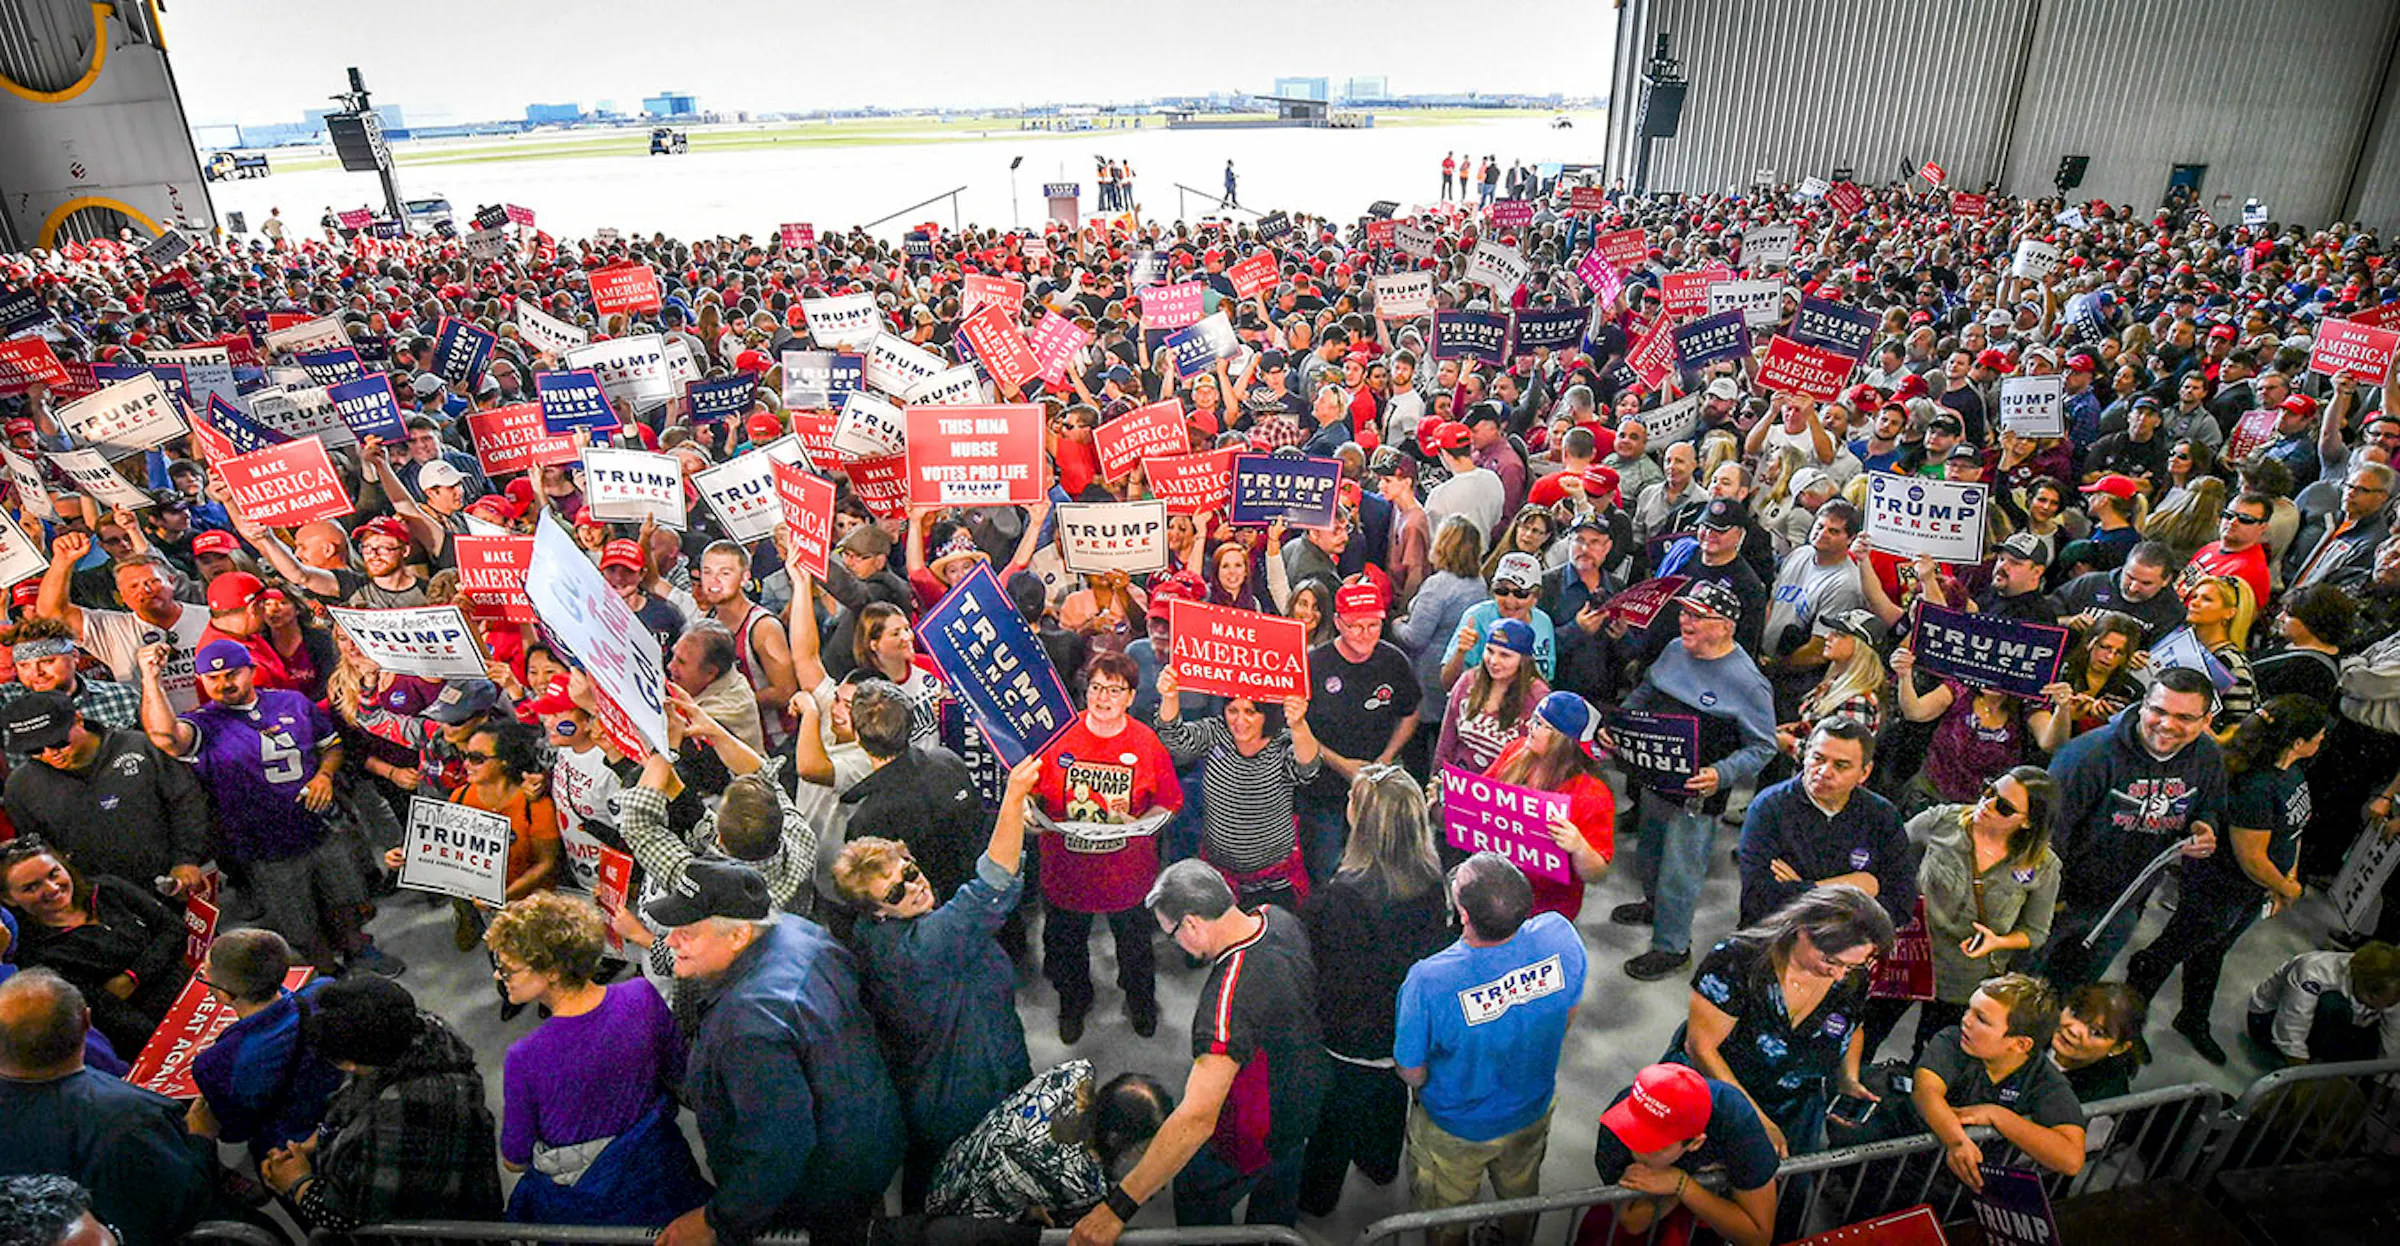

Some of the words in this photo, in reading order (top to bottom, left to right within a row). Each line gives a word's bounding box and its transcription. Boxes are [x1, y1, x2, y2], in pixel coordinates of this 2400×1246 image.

[1478, 251, 1520, 281] TRUMP
[1141, 285, 1201, 302] WOMEN
[1379, 283, 1428, 296] TRUMP
[1713, 290, 1778, 305] TRUMP
[810, 305, 872, 322] TRUMP
[1162, 301, 1184, 312] FOR
[1146, 313, 1200, 327] TRUMP
[1438, 321, 1504, 340] TRUMP
[1519, 319, 1584, 338] TRUMP
[1801, 310, 1872, 338] TRUMP
[1030, 310, 1061, 355] OMEN
[1443, 331, 1497, 346] PENCE
[1680, 321, 1741, 351] TRUMP
[1800, 320, 1861, 347] PENCE
[2341, 331, 2369, 345] MAKE
[444, 326, 468, 379] TRUMP
[977, 315, 1024, 385] AMERICA
[1047, 331, 1084, 379] TRUMP
[1794, 352, 1824, 369] MAKE
[2317, 336, 2390, 366] AMERICA
[0, 355, 58, 379] ERICA
[304, 362, 361, 381] TRUMP
[594, 353, 660, 372] RUMP
[604, 366, 656, 382] ENCE
[1764, 356, 1843, 385] AMERICA
[2317, 352, 2347, 367] GREAT
[2347, 360, 2383, 376] AGAIN
[790, 368, 862, 382] TRUMP
[1765, 369, 1799, 391] GREAT
[1800, 379, 1837, 396] AGAIN
[337, 391, 391, 417] TRUMP
[541, 386, 599, 405] TRUMP
[691, 381, 754, 406] TRUMP
[70, 393, 158, 435] TRUMP
[265, 404, 338, 425] TRUM
[546, 400, 599, 413] PENCE
[503, 413, 537, 428] MAKE
[852, 408, 906, 445] TRUM
[939, 418, 974, 434] THIS
[976, 417, 1009, 434] MNA
[1121, 416, 1151, 434] MAKE
[1647, 406, 1696, 431] RUMP
[480, 425, 546, 452] AMERI
[852, 423, 901, 453] PENC
[950, 441, 998, 458] NURSE
[1102, 424, 1184, 462] AMERICA
[489, 446, 528, 462] GREAT
[530, 440, 570, 456] AGAIN
[1110, 451, 1143, 470] GREAT
[1141, 440, 1181, 458] AGAIN
[247, 459, 289, 479] MAKE
[594, 470, 677, 489] TRUMP
[865, 466, 895, 480] MAKE
[920, 465, 972, 482] VOTES
[973, 464, 998, 481] PRO
[1001, 463, 1028, 480] LIFE
[1178, 464, 1213, 477] MAKE
[237, 465, 334, 507] AMERICA
[603, 484, 671, 499] PENCE
[780, 478, 805, 502] MAKE
[948, 482, 1002, 492] TRUMP
[1154, 470, 1233, 495] AMERIC
[1239, 473, 1334, 493] TRUMP
[247, 499, 290, 521] GREAT
[291, 488, 335, 512] AGAIN
[729, 496, 768, 515] PEN
[1164, 490, 1202, 507] GREAT
[1245, 488, 1322, 503] PENCE
[1873, 495, 1975, 521] TRUMP
[1066, 521, 1160, 538] TRUMP
[1878, 513, 1961, 534] PENCE
[1075, 537, 1151, 549] PENCE
[483, 551, 514, 564] MAKE
[461, 568, 529, 589] AMERIC
[471, 592, 508, 606] GREAT
[352, 628, 461, 644] TRUMP
[1212, 621, 1257, 643] MAKE
[1921, 620, 2054, 661] TRUMP
[370, 642, 457, 655] PENCE
[1175, 634, 1303, 673] AMERICA
[1929, 640, 2036, 672] PENCE
[960, 590, 1055, 733] TRUMP
[952, 618, 1036, 731] PENCE
[1180, 662, 1232, 683] GREAT
[1238, 668, 1294, 689] AGAIN
[260, 731, 304, 783] 5
[1620, 746, 1692, 774] TRUM
[982, 752, 993, 799] PEN
[1070, 768, 1129, 782] DONALD
[1445, 768, 1568, 822] WOMEN
[1480, 811, 1525, 836] FOR
[416, 823, 502, 857] TRUMP
[1452, 824, 1560, 874] TRUMP
[422, 844, 493, 871] PENCE
[1470, 965, 1552, 1004] TRUMP
[1483, 978, 1546, 1012] PENCE
[1971, 1200, 2050, 1246] TRUMP
